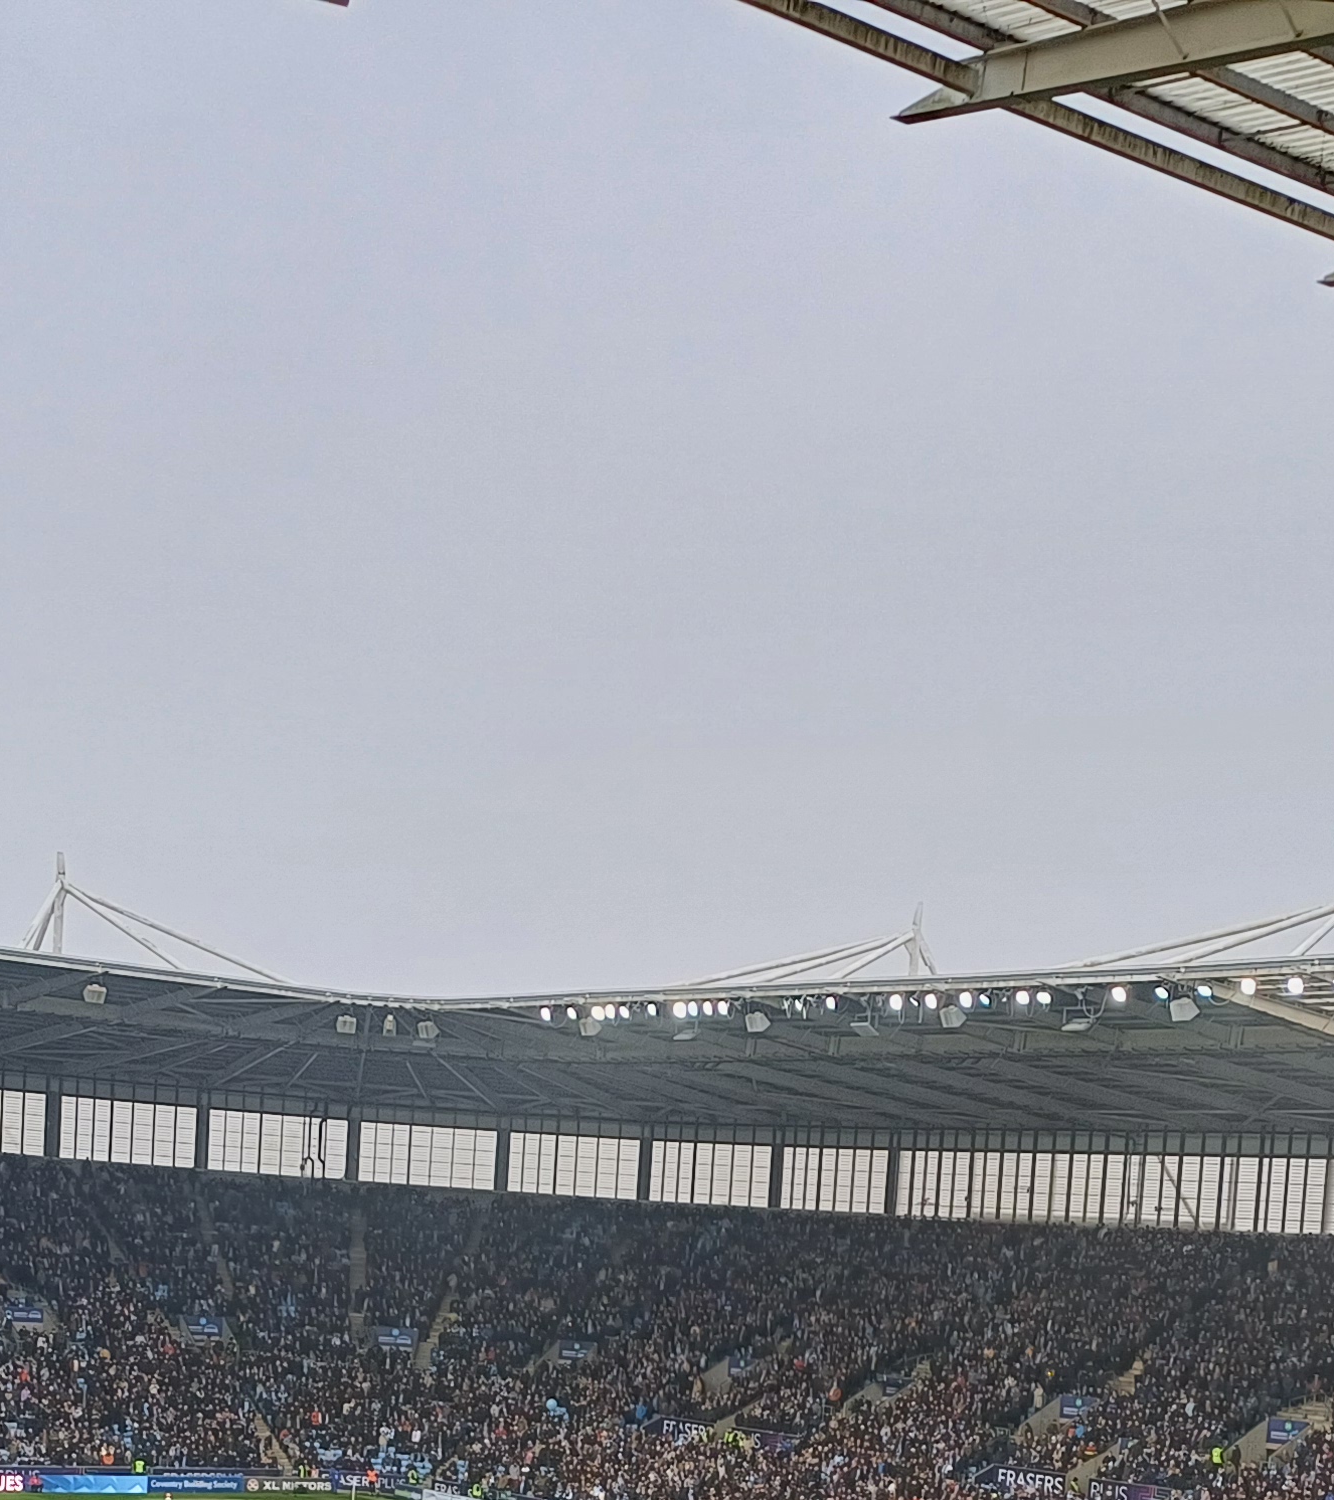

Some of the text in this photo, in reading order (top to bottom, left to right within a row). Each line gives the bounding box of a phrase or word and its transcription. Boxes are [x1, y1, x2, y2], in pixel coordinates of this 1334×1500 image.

[150, 1479, 183, 1489] Coventry
[213, 1480, 238, 1489] Society
[263, 1481, 280, 1490] XL
